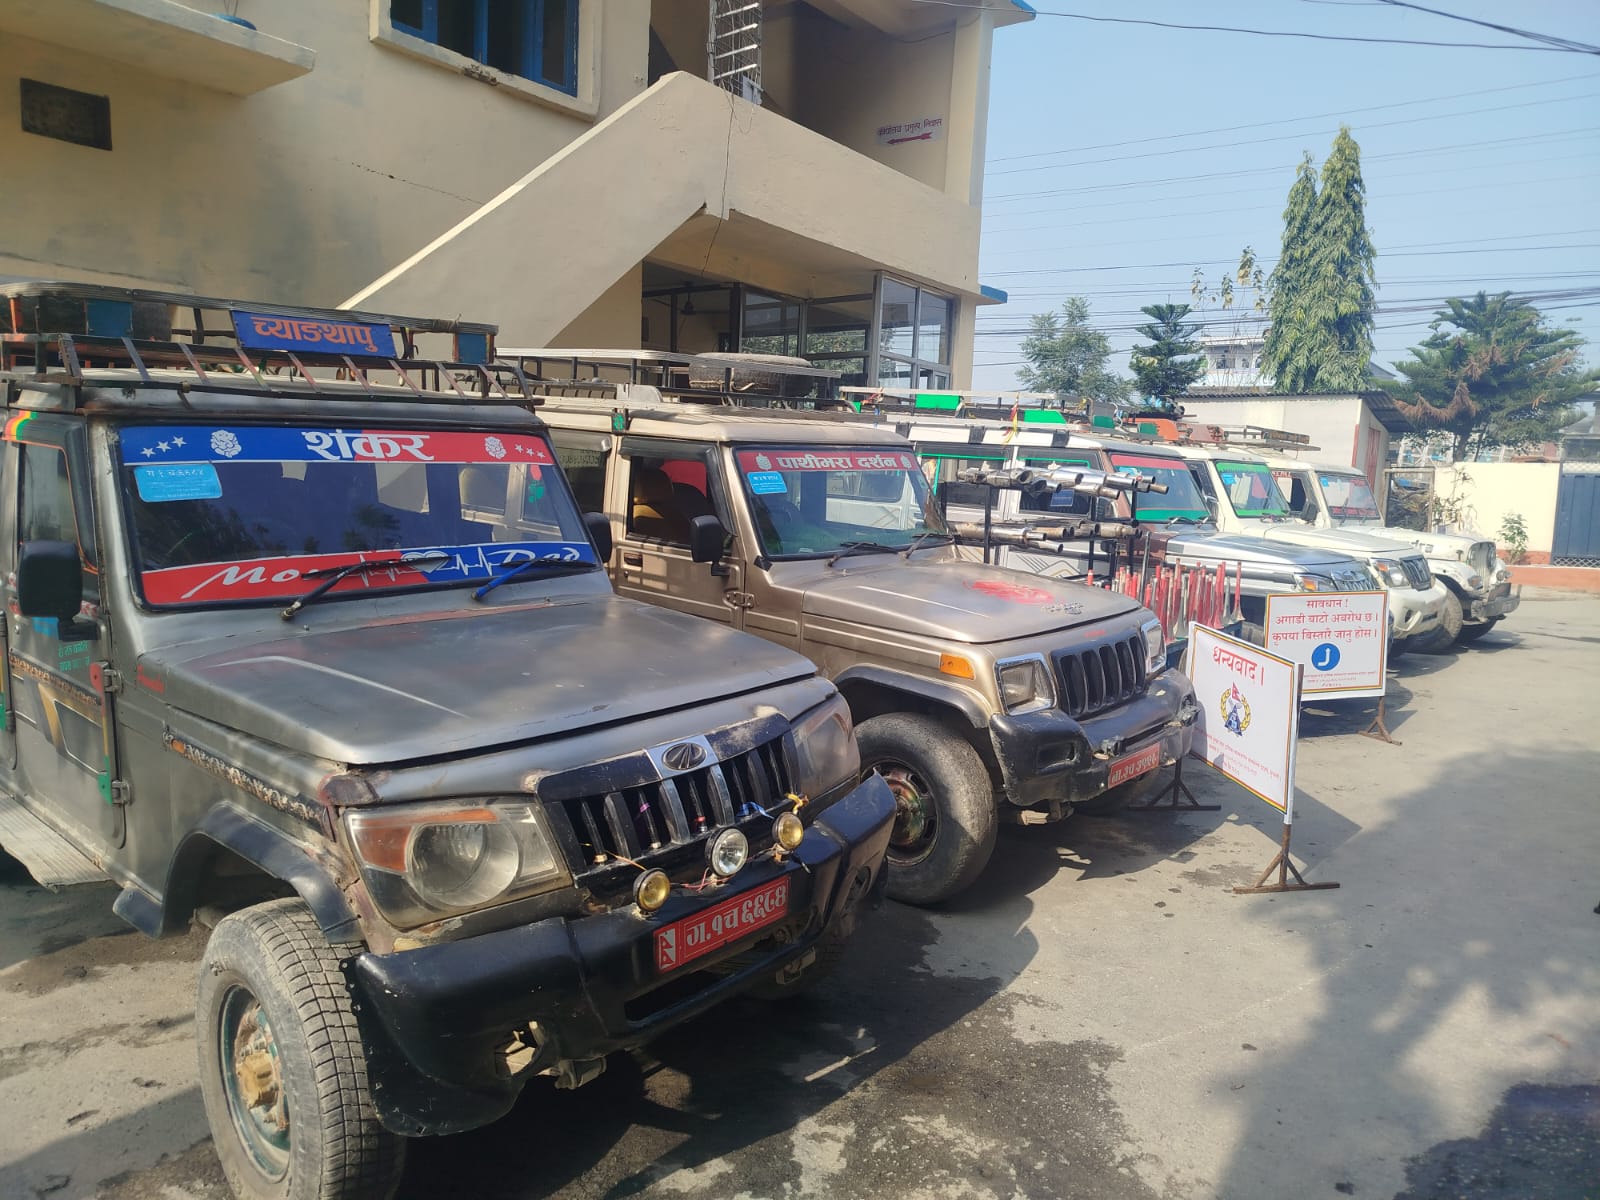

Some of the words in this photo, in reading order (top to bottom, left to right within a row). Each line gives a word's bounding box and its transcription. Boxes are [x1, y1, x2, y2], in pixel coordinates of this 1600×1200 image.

[301, 429, 434, 461] शंकर
[856, 455, 897, 468] दर्शन
[181, 565, 320, 598] Mo
[1306, 599, 1342, 608] सावधान
